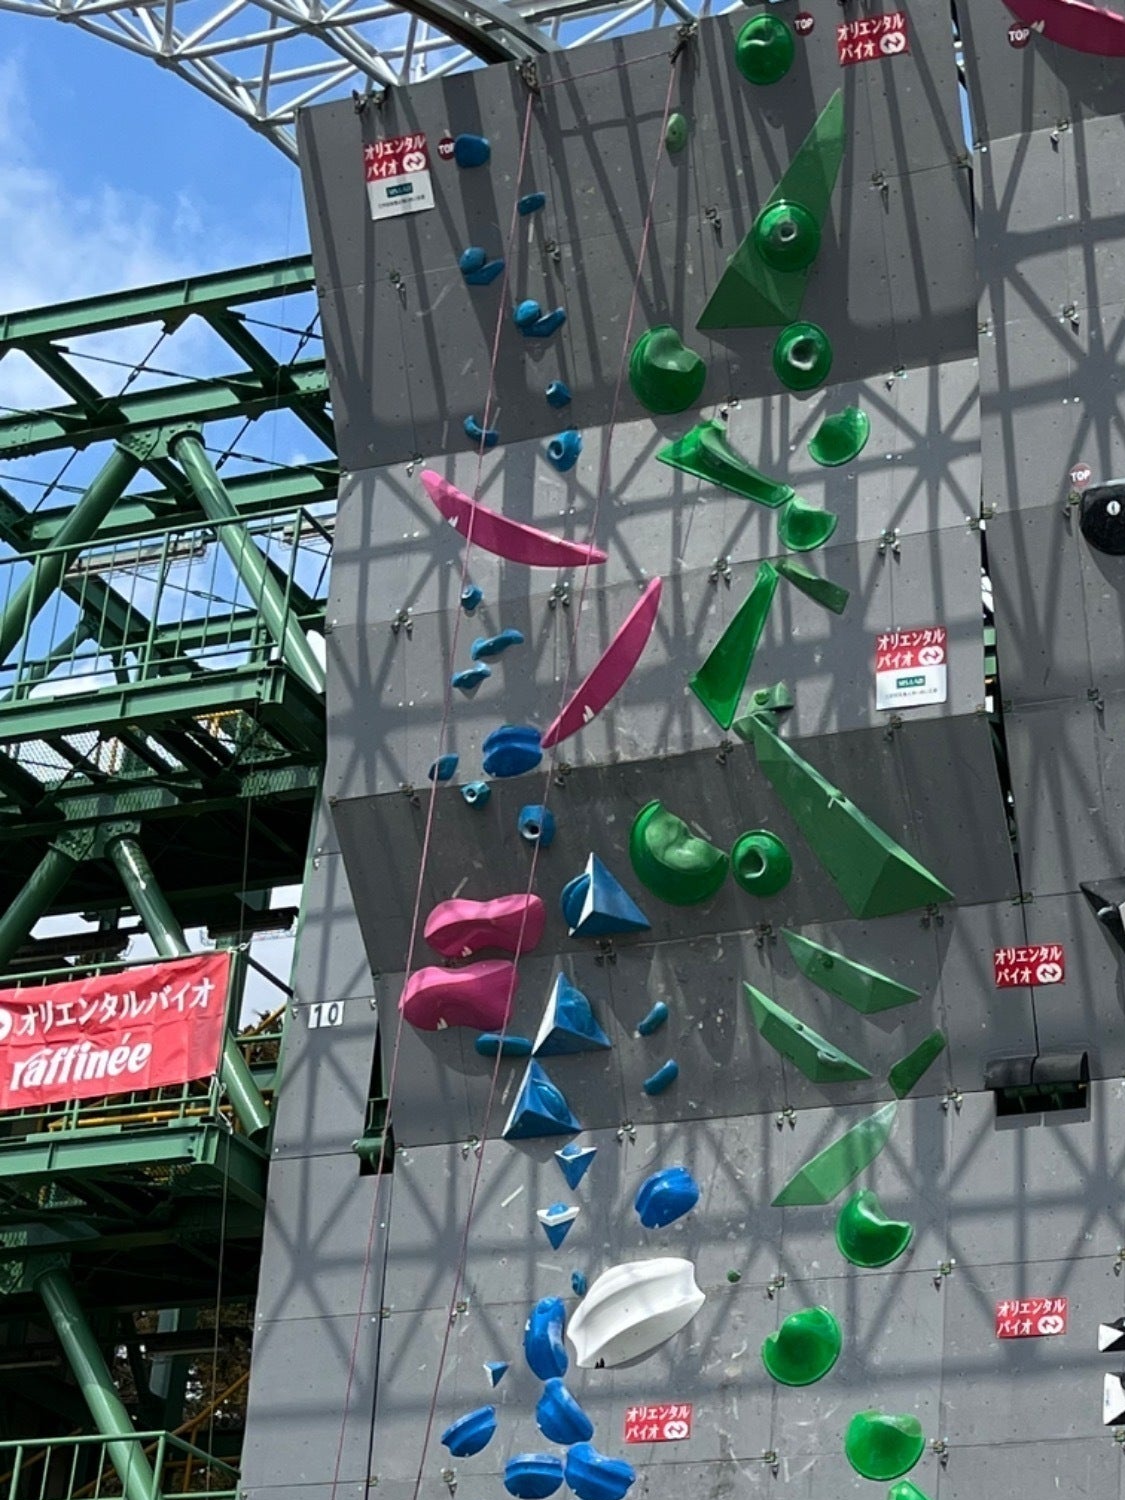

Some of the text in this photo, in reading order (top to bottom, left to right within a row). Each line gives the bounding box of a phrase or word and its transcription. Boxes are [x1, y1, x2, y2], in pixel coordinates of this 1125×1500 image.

[794, 18, 814, 30] TOP
[838, 13, 904, 41] オリエンタル
[1008, 29, 1029, 41] TOP
[841, 40, 876, 61] バイオ
[365, 136, 426, 160] オリエンタル
[1070, 470, 1091, 481] TOP
[878, 628, 945, 651] オリエンタル
[877, 650, 914, 669] バイオ
[995, 946, 1062, 965] オリエンタル
[997, 966, 1032, 984] バイオ
[17, 977, 215, 1037] オリエンタルバイオ
[315, 1003, 338, 1028] 10
[9, 1032, 152, 1091] raffinée
[998, 1299, 1065, 1317] オリエンタル
[997, 1318, 1032, 1336] バイオ
[626, 1405, 690, 1422] オリエンタル
[626, 1423, 659, 1440] バイオ
